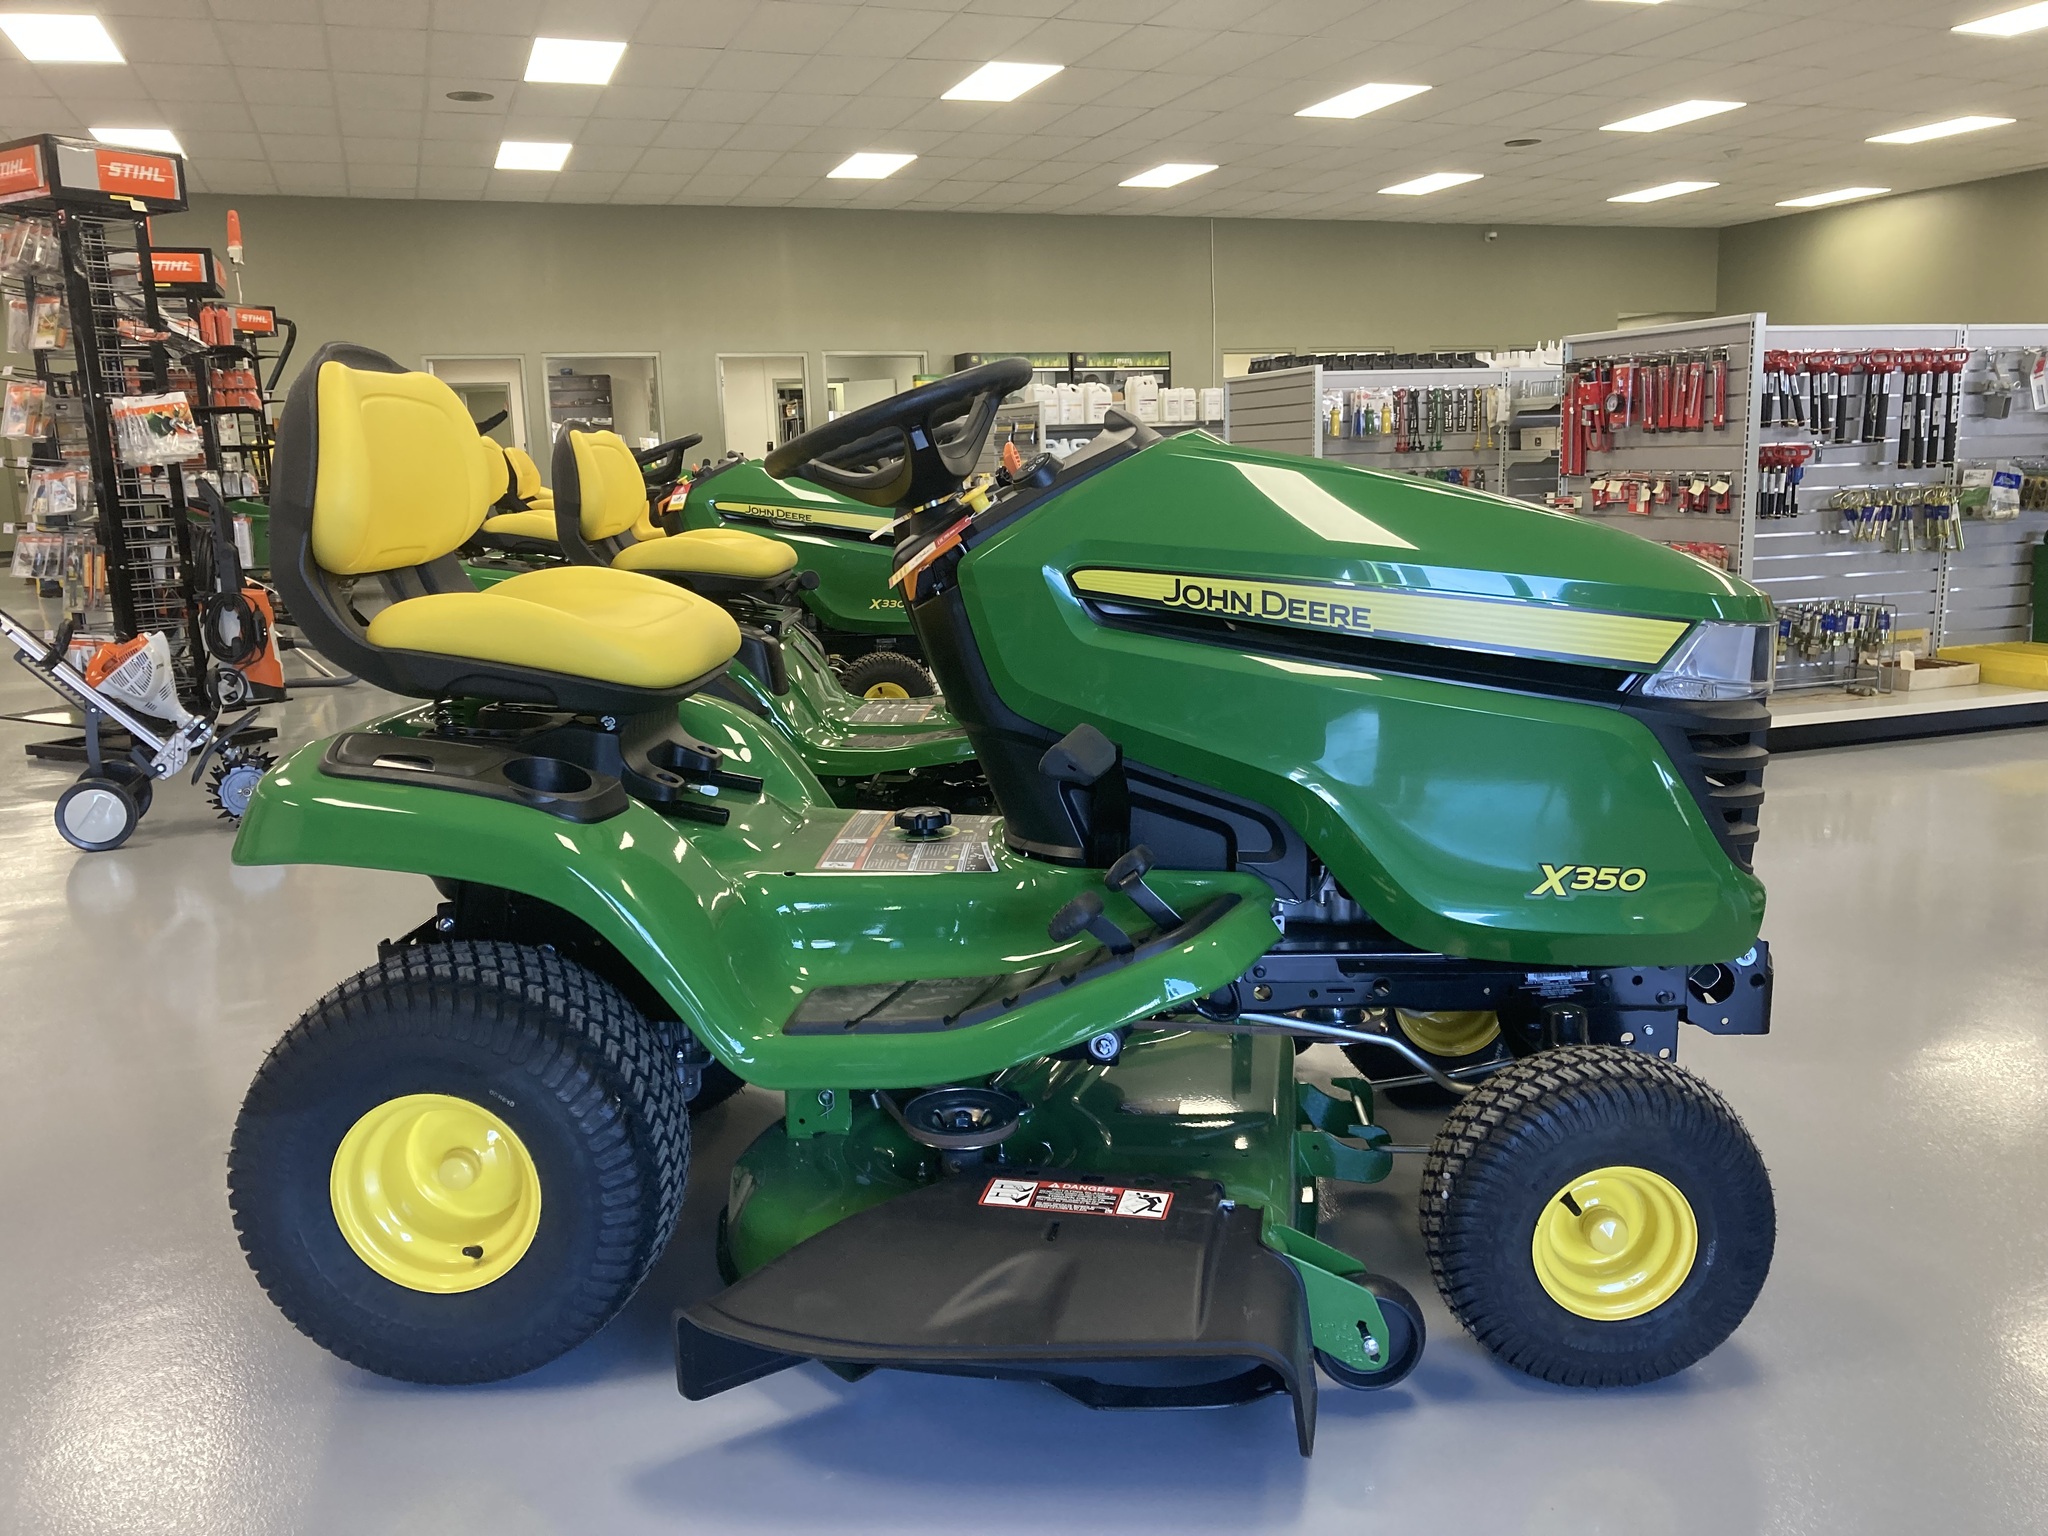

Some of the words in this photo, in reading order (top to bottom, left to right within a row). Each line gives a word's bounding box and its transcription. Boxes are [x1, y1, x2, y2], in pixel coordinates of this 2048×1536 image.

[0, 158, 27, 176] TIHL
[108, 161, 166, 183] STIHL
[241, 313, 268, 324] STIHL
[745, 505, 774, 517] JOHN
[776, 509, 812, 522] DEERE
[1163, 578, 1252, 614] JOHN
[1261, 589, 1372, 630] DEERE
[1528, 862, 1648, 898] X350
[1062, 1183, 1115, 1194] DANGER
